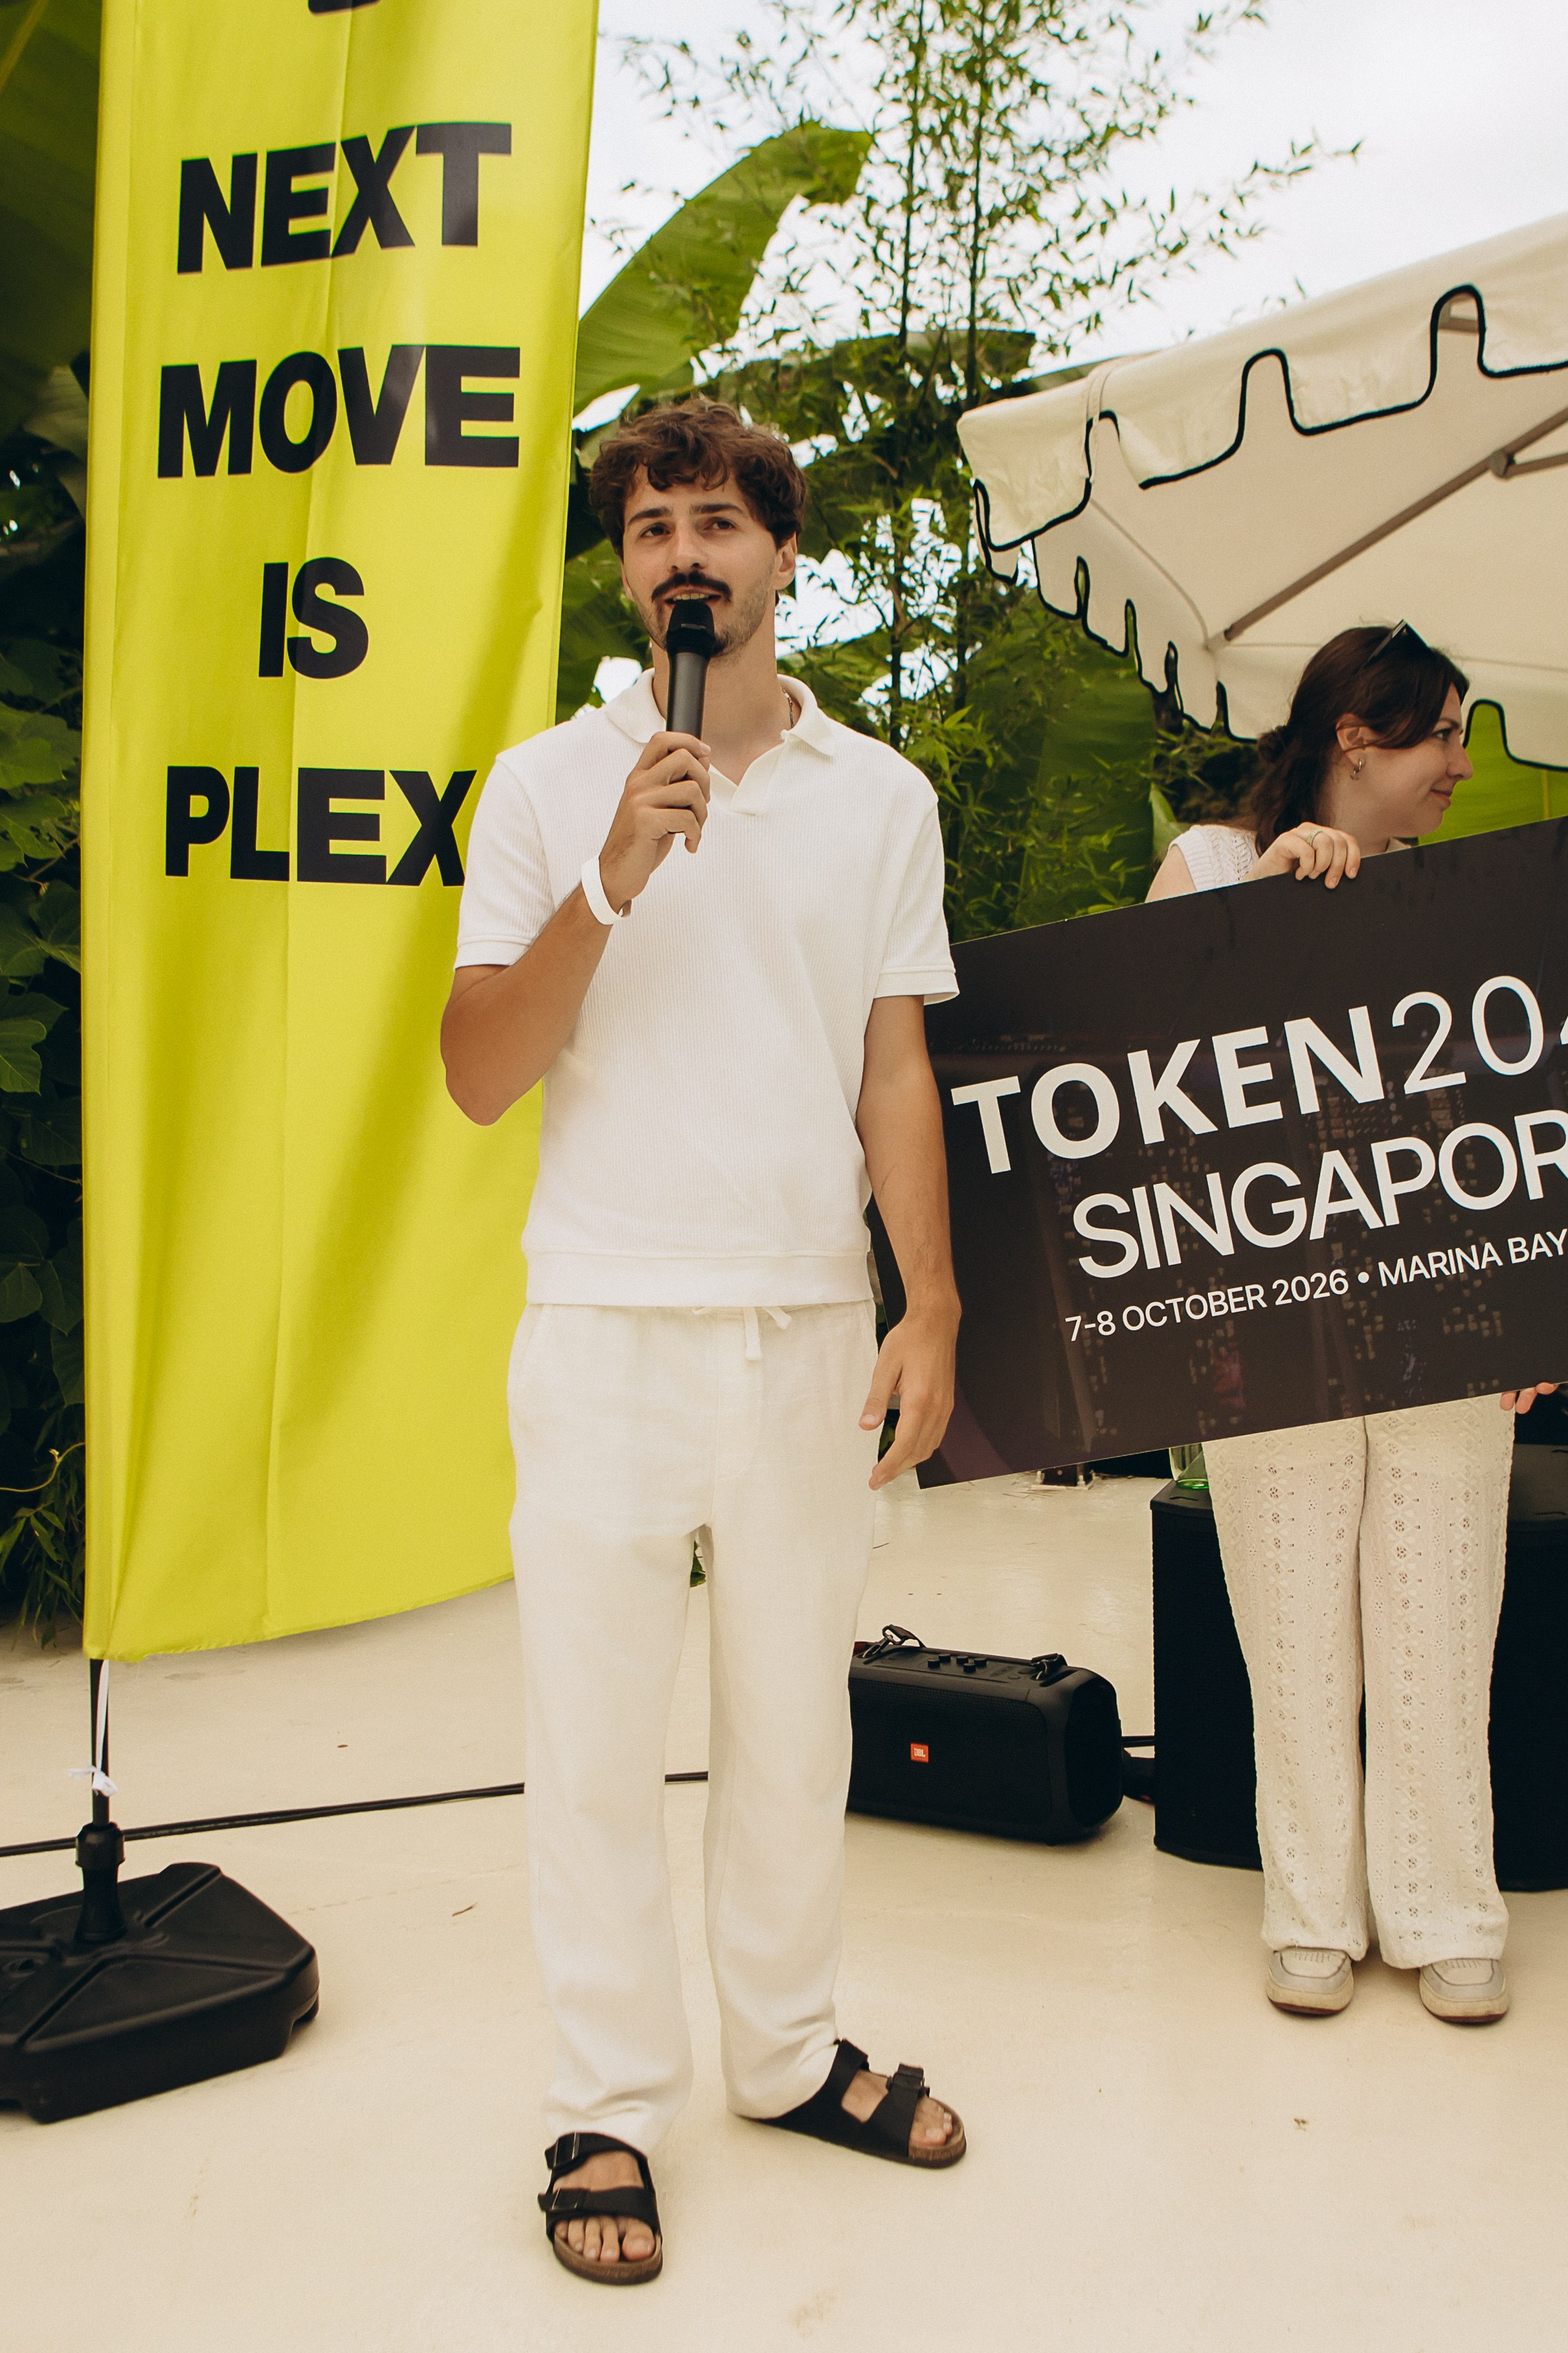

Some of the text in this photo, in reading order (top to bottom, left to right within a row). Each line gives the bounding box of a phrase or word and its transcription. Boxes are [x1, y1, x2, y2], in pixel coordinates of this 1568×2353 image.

[177, 121, 512, 276] NEXT
[157, 343, 520, 479] MOVE
[258, 556, 369, 679] IS
[165, 765, 478, 887] PLEX
[951, 975, 1568, 1174] TOKEN20
[1064, 1228, 1568, 1342] 7-8 OCTOBER 2026 MARINA BAY
[914, 1747, 926, 1757] JBL
